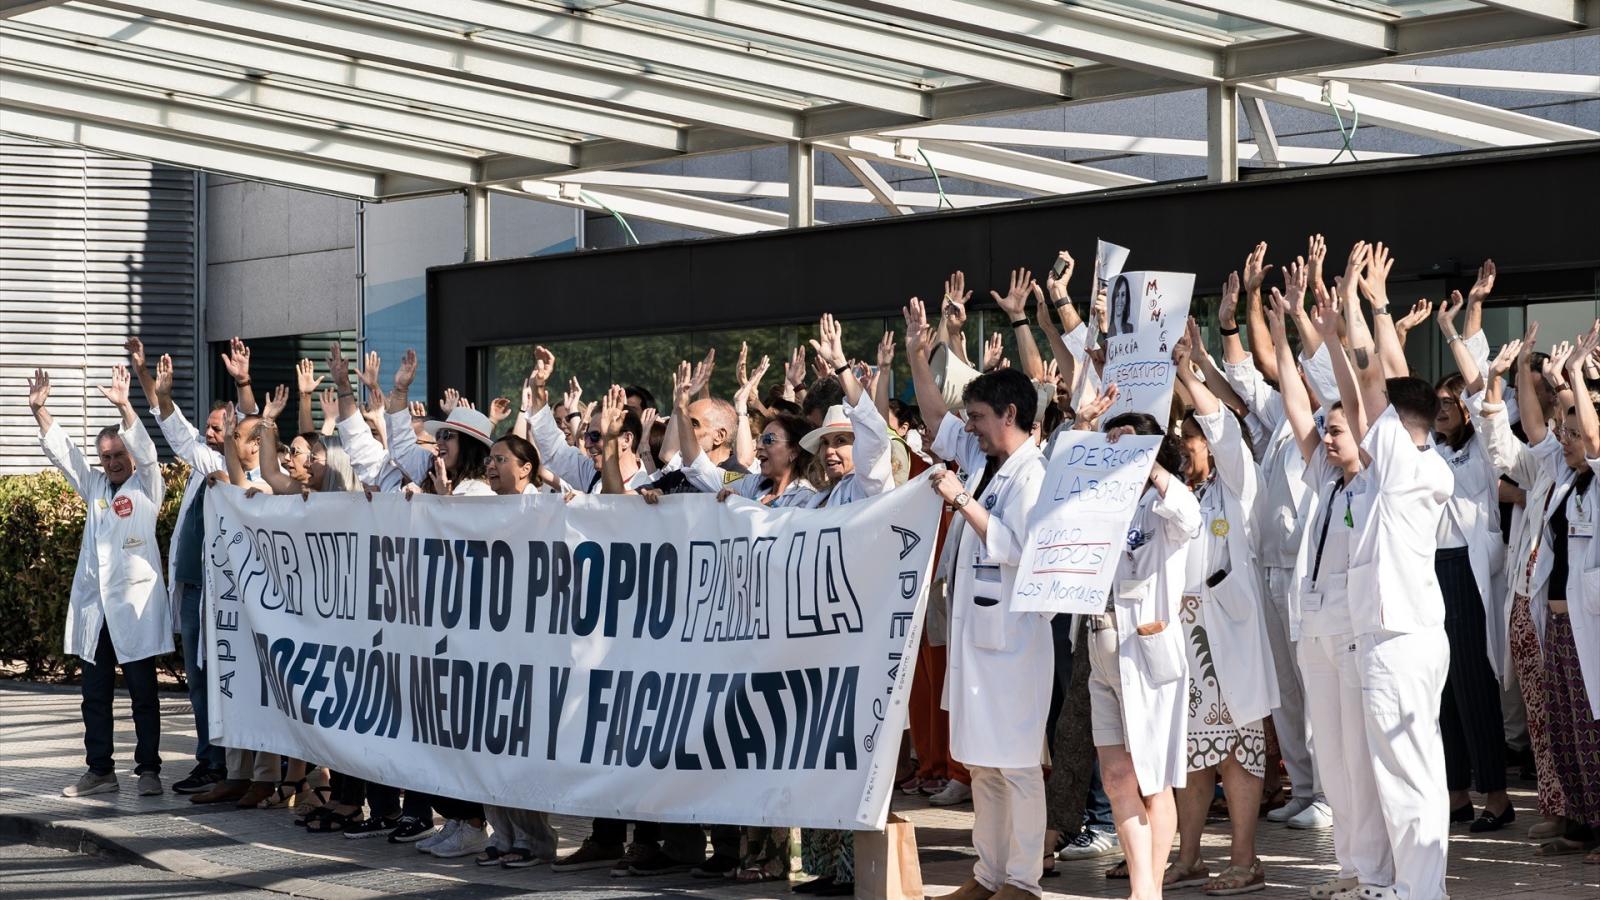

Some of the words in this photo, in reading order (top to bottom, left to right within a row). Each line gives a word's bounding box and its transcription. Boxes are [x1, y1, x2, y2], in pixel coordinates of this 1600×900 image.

[1108, 338, 1139, 361] GARCÍA
[1116, 364, 1166, 383] ESTATUTO
[1067, 445, 1154, 468] DERECHOS
[1039, 544, 1105, 567] TODOS
[238, 525, 303, 616] POR
[305, 531, 358, 621] UN
[367, 534, 514, 632] ESTATUTO
[524, 540, 678, 640] PROPIO
[681, 536, 777, 642] PARA
[786, 527, 864, 639] LA
[1016, 578, 1043, 597] LOS
[409, 634, 534, 758] MÉDICA
[546, 666, 571, 761] Y
[579, 666, 860, 771] FACULTATIVA
